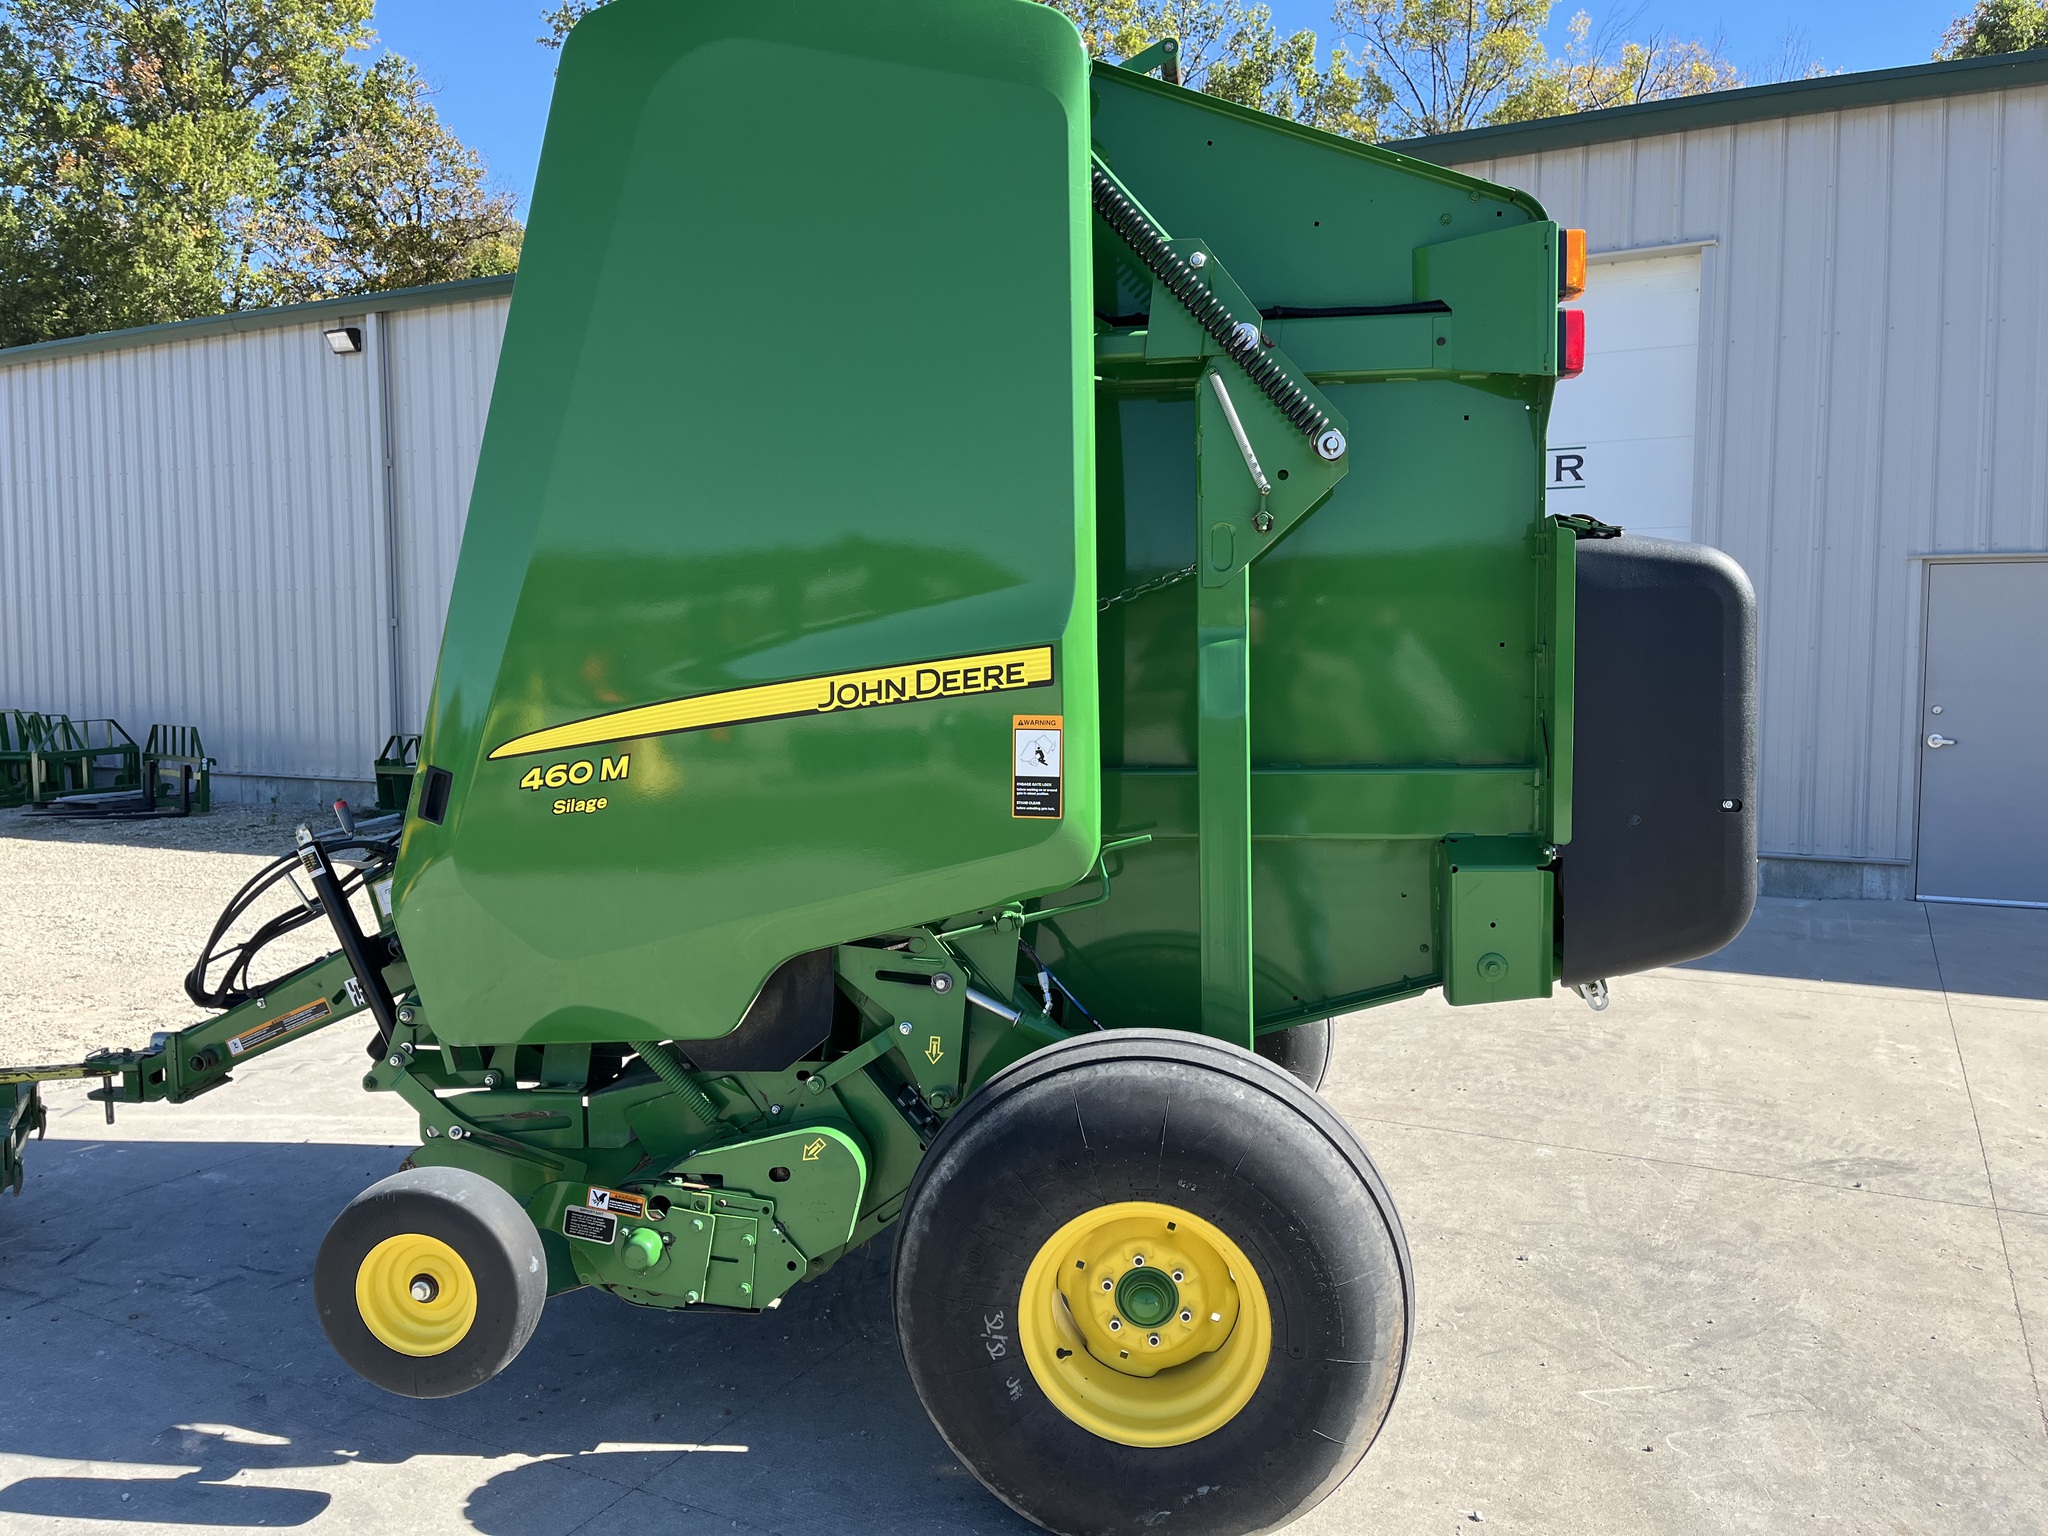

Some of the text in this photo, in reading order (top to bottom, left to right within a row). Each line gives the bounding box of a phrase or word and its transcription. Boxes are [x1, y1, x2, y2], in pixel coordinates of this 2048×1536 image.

[818, 662, 1025, 708] JOHN DEERE
[1023, 719, 1057, 727] WARNING
[519, 753, 631, 791] 460 M
[552, 797, 608, 815] Silage
